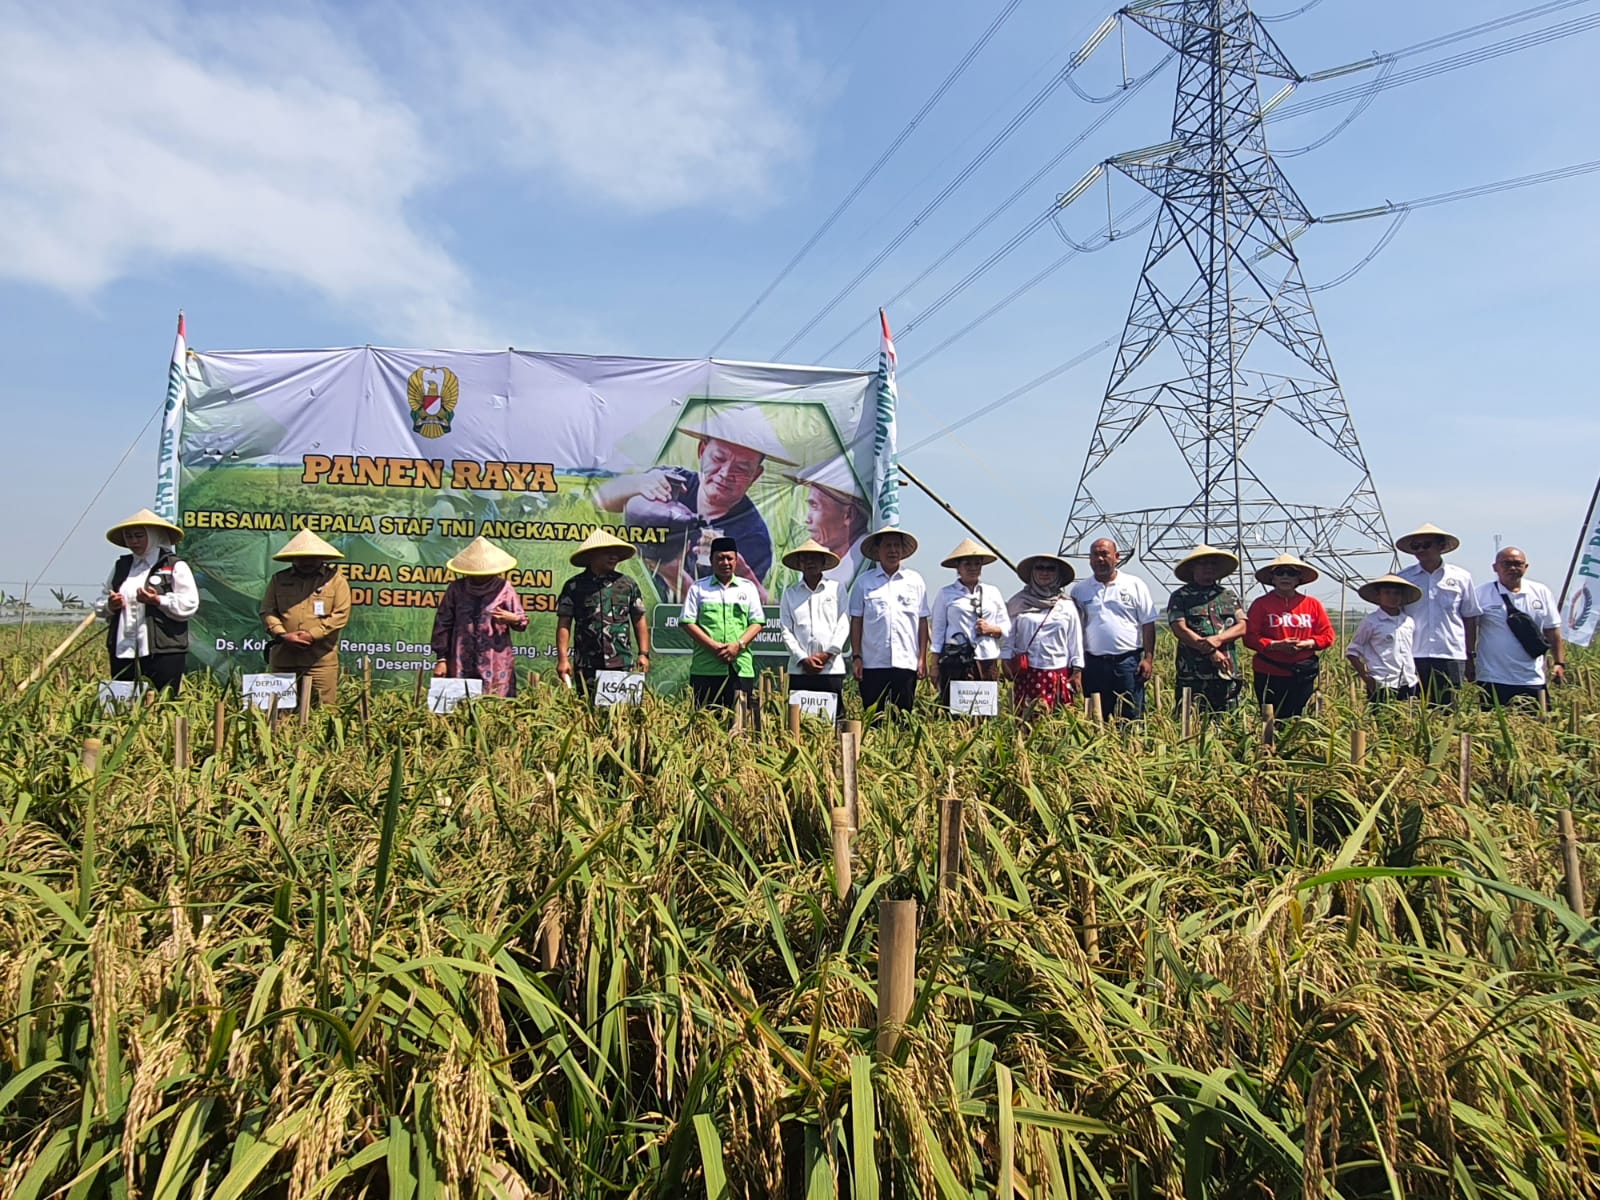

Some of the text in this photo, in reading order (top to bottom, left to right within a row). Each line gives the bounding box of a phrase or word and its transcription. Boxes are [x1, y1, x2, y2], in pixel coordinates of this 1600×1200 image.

[302, 455, 558, 492] PANEN RAYA
[183, 510, 286, 530] BERSAMA
[291, 513, 374, 533] KEPALA
[379, 516, 433, 536] STAF
[438, 519, 475, 537] TNI
[480, 520, 597, 542] ANGKATAN
[398, 565, 456, 584] SAMA
[1267, 612, 1312, 628] DIOR
[215, 638, 239, 651] Ds.
[340, 639, 391, 655] Rengas
[396, 641, 434, 656] Deng
[800, 696, 828, 706] DIRUT
